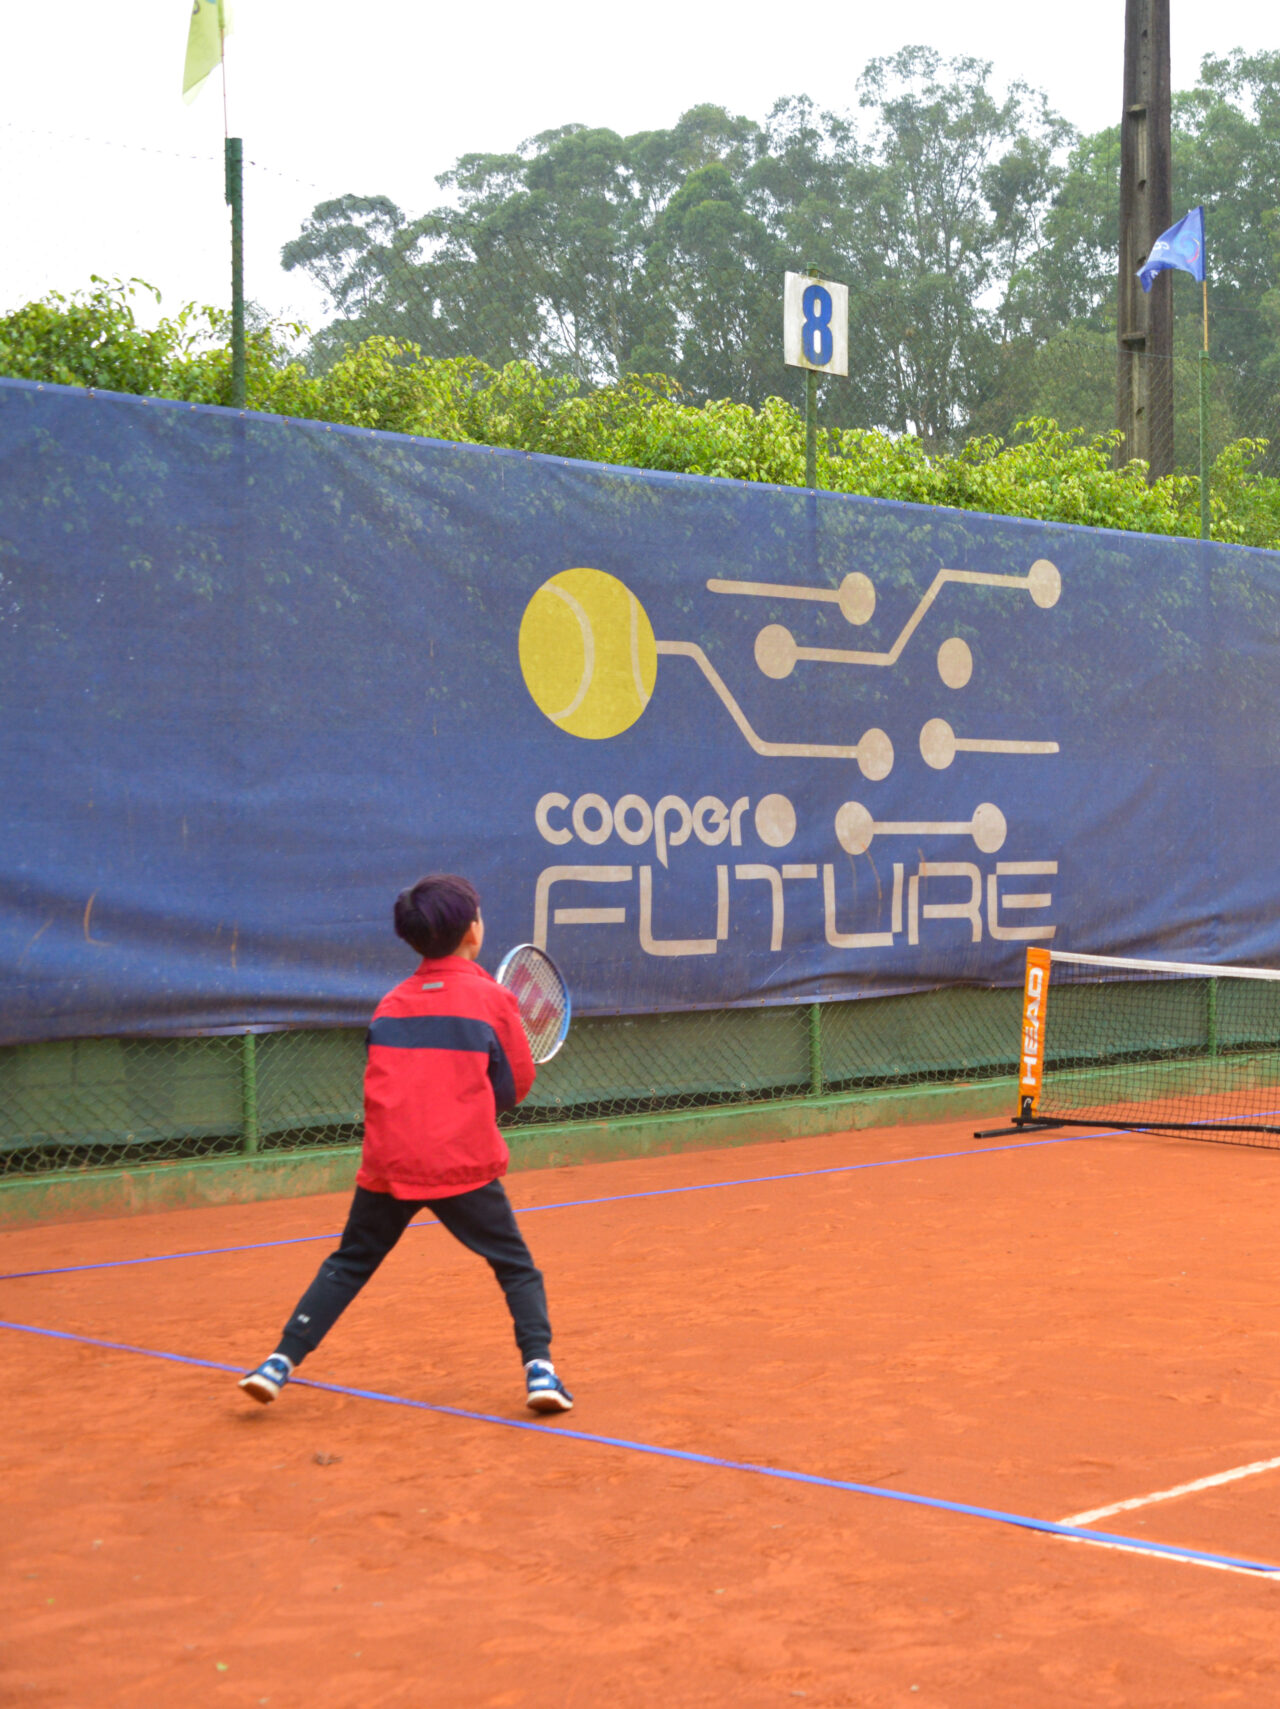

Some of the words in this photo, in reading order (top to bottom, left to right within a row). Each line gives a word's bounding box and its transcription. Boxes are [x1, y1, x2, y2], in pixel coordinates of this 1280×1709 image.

[802, 284, 833, 366] 8
[534, 792, 750, 869] cooper
[533, 861, 1059, 960] FUTURE
[1022, 967, 1044, 1086] HEAD
